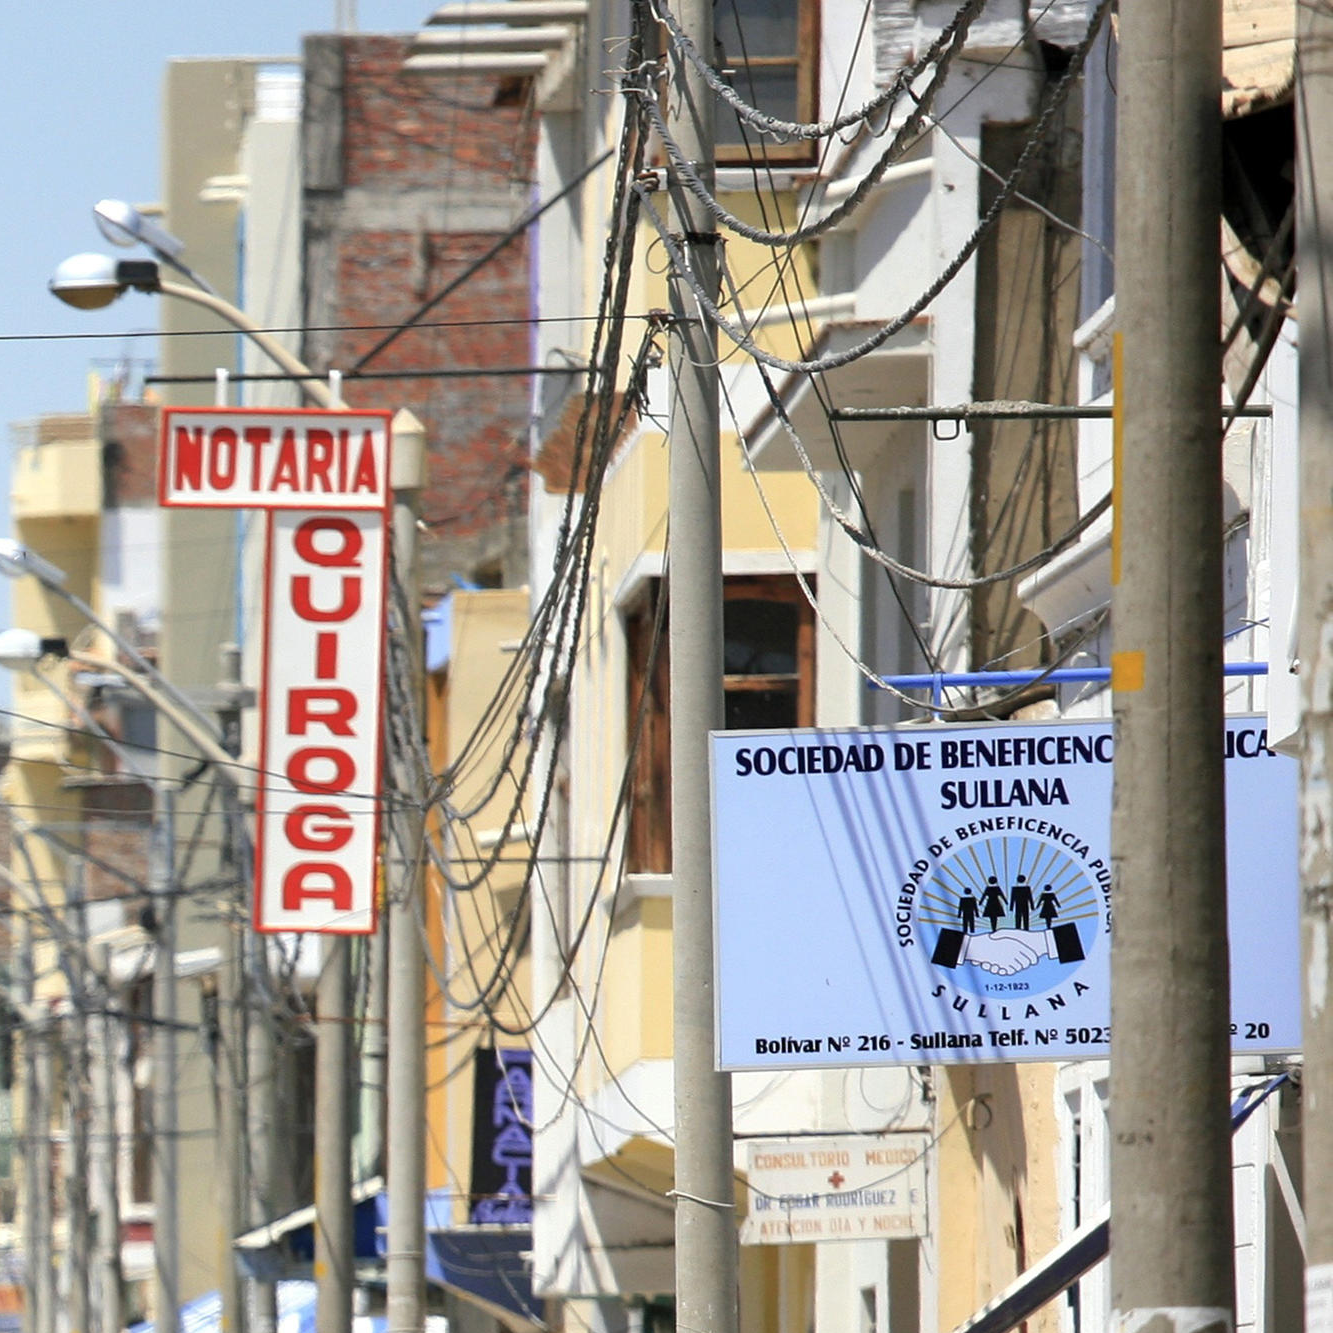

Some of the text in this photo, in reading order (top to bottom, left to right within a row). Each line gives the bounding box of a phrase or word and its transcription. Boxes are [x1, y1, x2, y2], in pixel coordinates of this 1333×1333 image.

[173, 425, 379, 494] NOTARIA
[280, 515, 366, 913] QUIROGA
[735, 741, 885, 776] SOCIEDAD
[893, 742, 932, 772] DE
[940, 777, 1071, 810] SULLANA
[896, 859, 930, 948] SOCIEDAD
[927, 836, 953, 858] DE
[954, 816, 1091, 860] BENEFICENCIA
[930, 981, 1090, 1021] SULLANA
[754, 1035, 822, 1055] Bolívar
[858, 1033, 891, 1051] 216
[910, 1032, 983, 1050] Sullana
[988, 1030, 1029, 1048] Telf.
[753, 1149, 918, 1171] CONSULTORIO MEDICO
